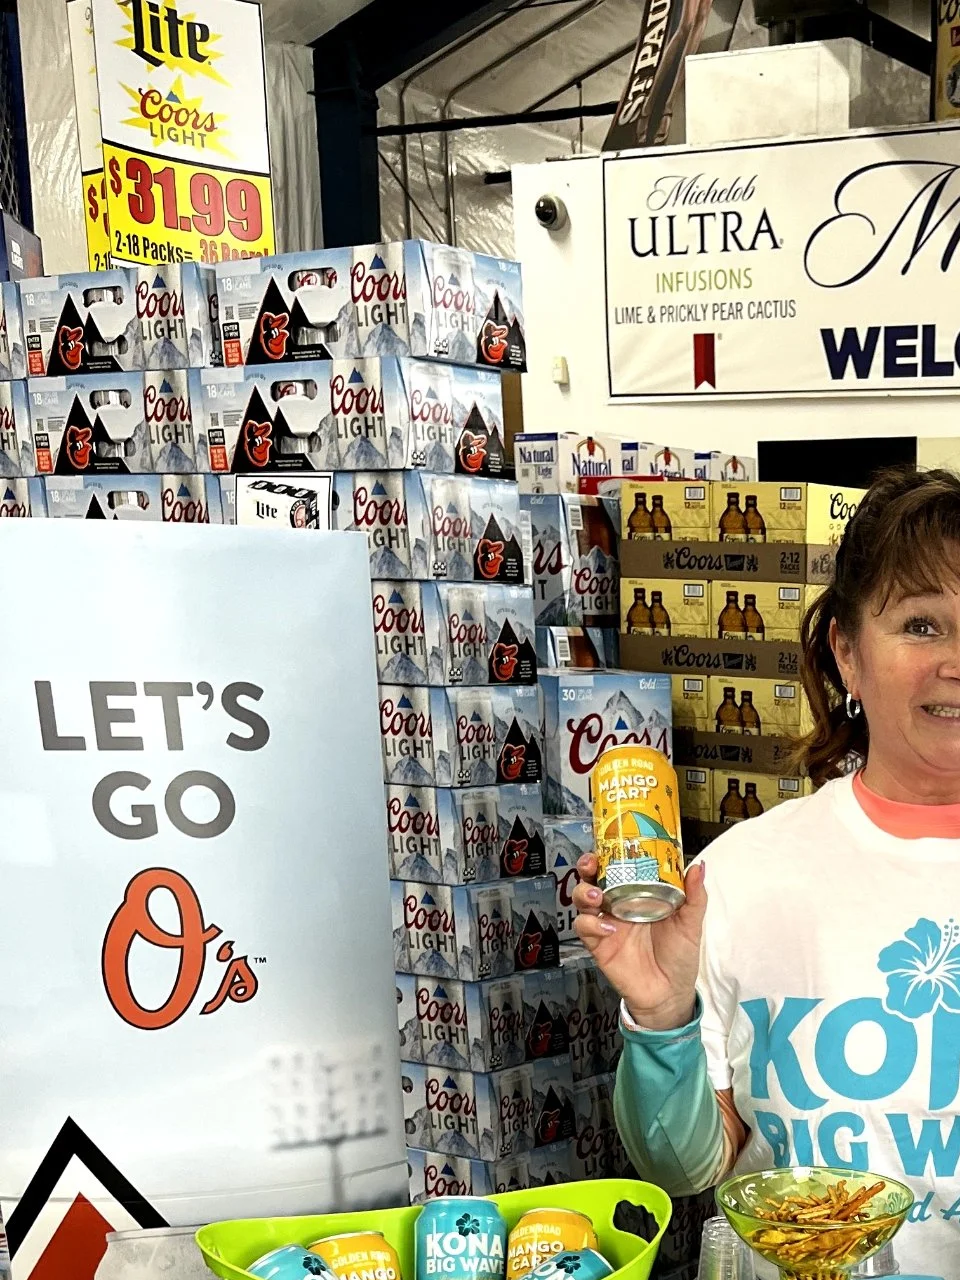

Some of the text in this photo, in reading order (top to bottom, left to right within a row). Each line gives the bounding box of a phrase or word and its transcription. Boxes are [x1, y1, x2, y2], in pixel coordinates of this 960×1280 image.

[131, 0, 210, 67] Lite
[138, 88, 218, 132] Coors
[150, 122, 206, 148] LIGHT
[108, 156, 263, 242] $31.99
[646, 173, 758, 213] Michelob
[115, 230, 140, 257] 2-18
[627, 207, 781, 257] ULTRA
[350, 261, 406, 303] Coors
[655, 267, 753, 294] INFUSIONS
[136, 281, 185, 319] Coors
[614, 298, 797, 326] LIME & PRICKLY PEAR CACTUS
[356, 302, 406, 327] LIGHT
[142, 318, 185, 340] LIGHT
[144, 385, 192, 423] Coors
[330, 374, 384, 416] Coors
[520, 446, 554, 463] Natural
[256, 501, 278, 518] Lite
[353, 487, 407, 526] Coors
[373, 594, 424, 634] Coors
[376, 635, 425, 655] LIGHT
[563, 689, 575, 700] 30
[639, 679, 656, 689] Cold
[35, 680, 271, 752] LET'S
[380, 698, 433, 737] Coors
[599, 774, 658, 794] MANGO
[607, 786, 650, 803] CART
[92, 769, 236, 841] GO
[387, 797, 440, 835] Coors
[391, 835, 439, 856] LIGHT
[417, 987, 466, 1025] Coors
[421, 1024, 466, 1044] LIGHT
[754, 1110, 868, 1171] BIG
[426, 1233, 504, 1259] KONA
[508, 1240, 564, 1258] MANGO
[425, 1258, 504, 1273] BIG WAVE
